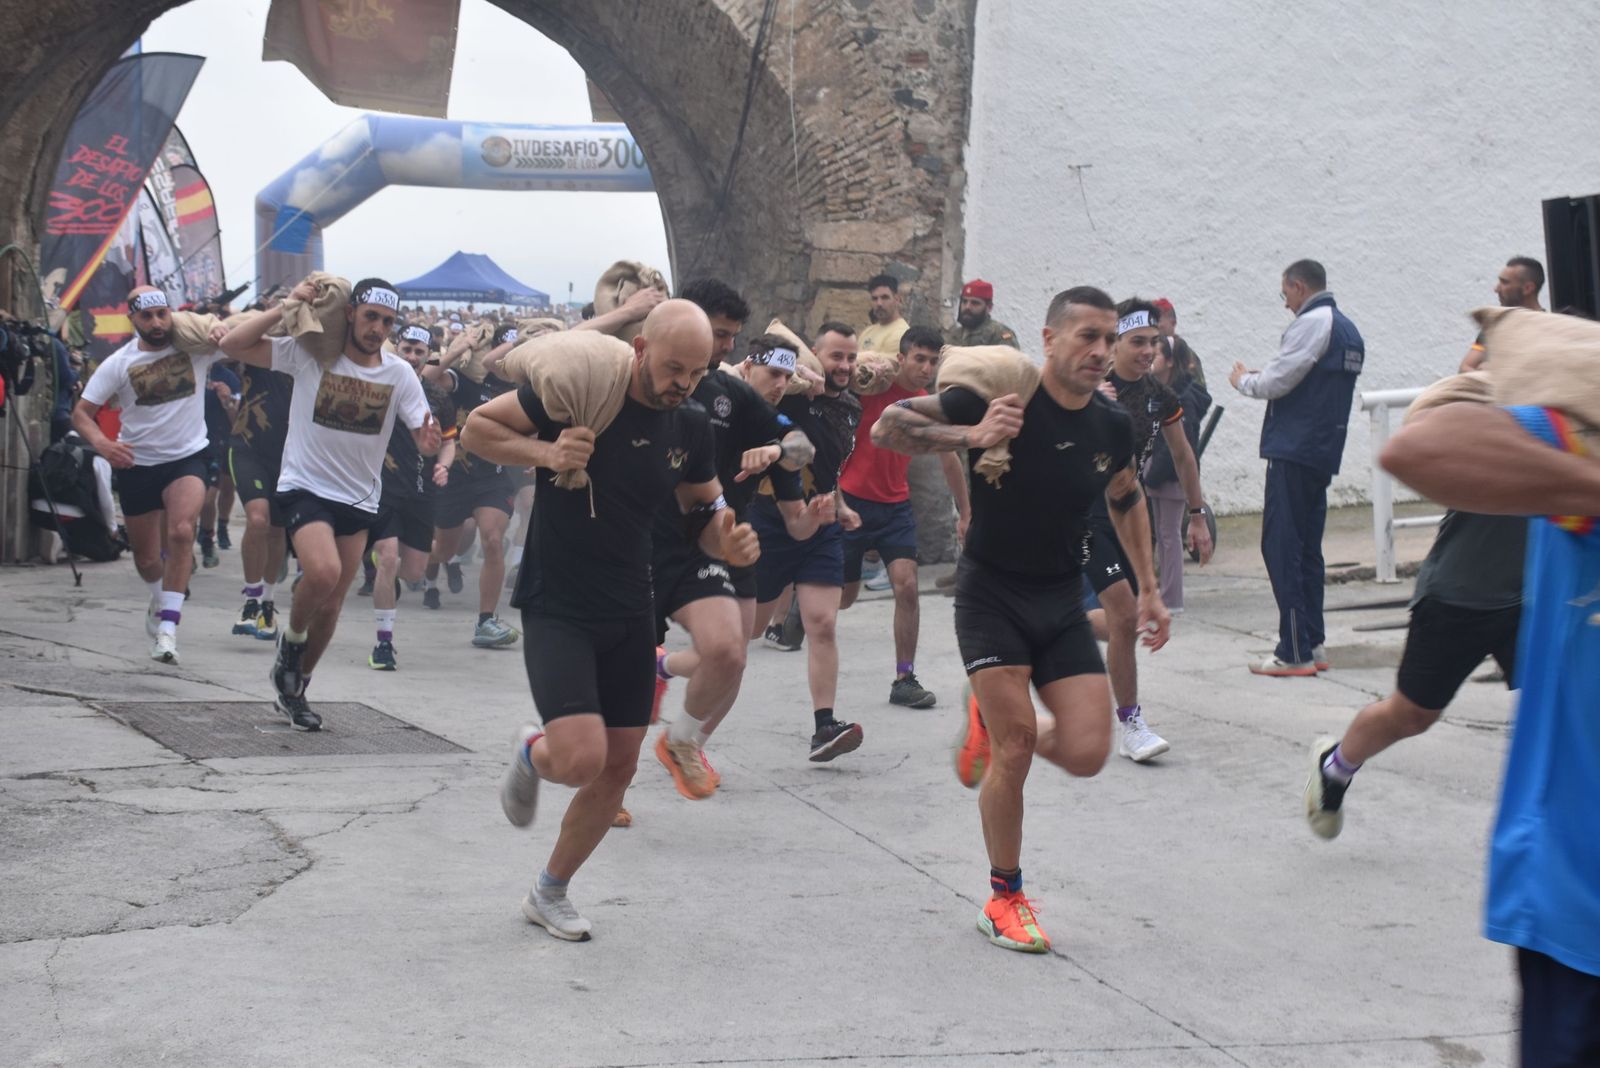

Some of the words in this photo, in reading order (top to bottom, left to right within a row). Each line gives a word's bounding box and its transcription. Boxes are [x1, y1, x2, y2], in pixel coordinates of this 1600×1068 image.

[104, 133, 129, 156] EL
[64, 168, 100, 190] DE
[97, 180, 131, 202] LOS
[46, 191, 125, 221] 300
[1120, 315, 1144, 330] 5041
